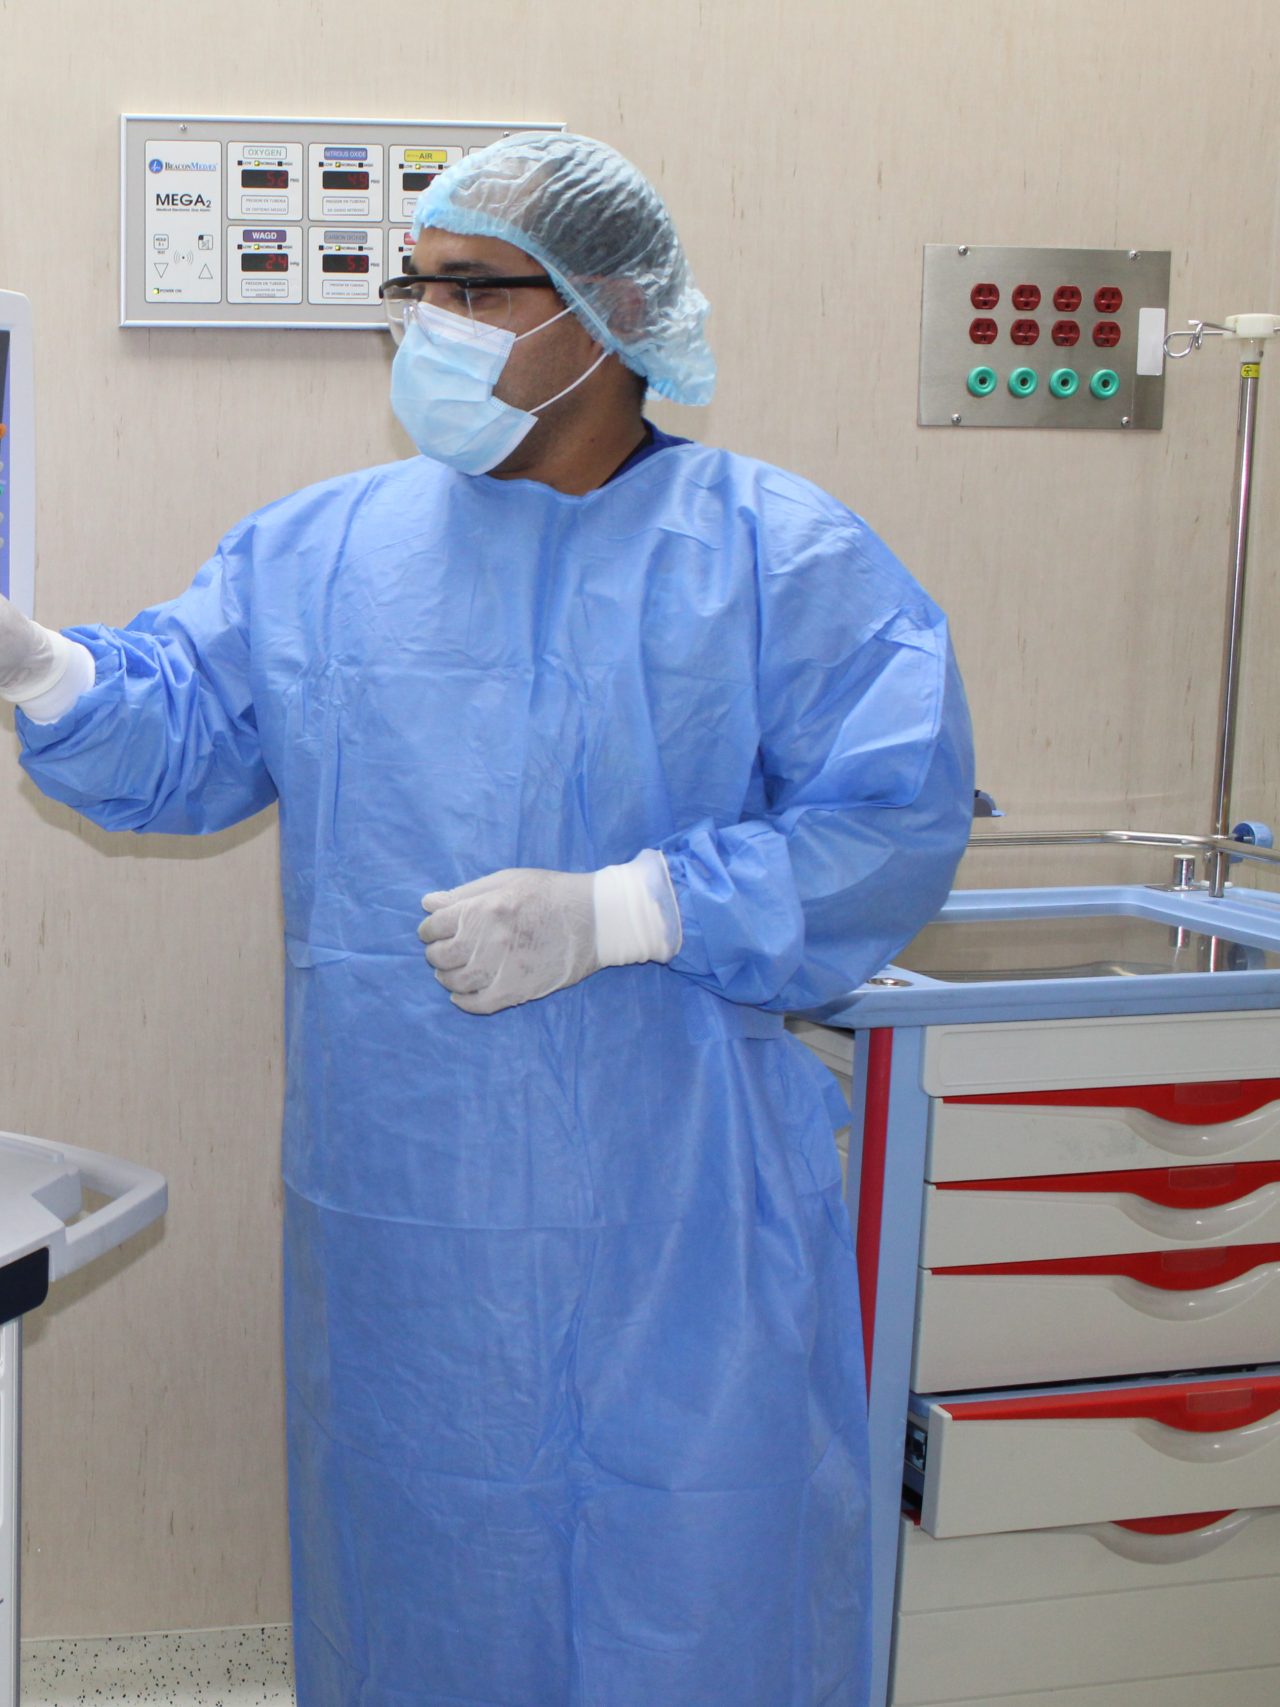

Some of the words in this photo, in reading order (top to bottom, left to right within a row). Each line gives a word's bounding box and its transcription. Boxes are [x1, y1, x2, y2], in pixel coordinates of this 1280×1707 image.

[247, 148, 282, 157] OXYGEN
[419, 152, 433, 160] AIR
[252, 231, 277, 240] WAGD
